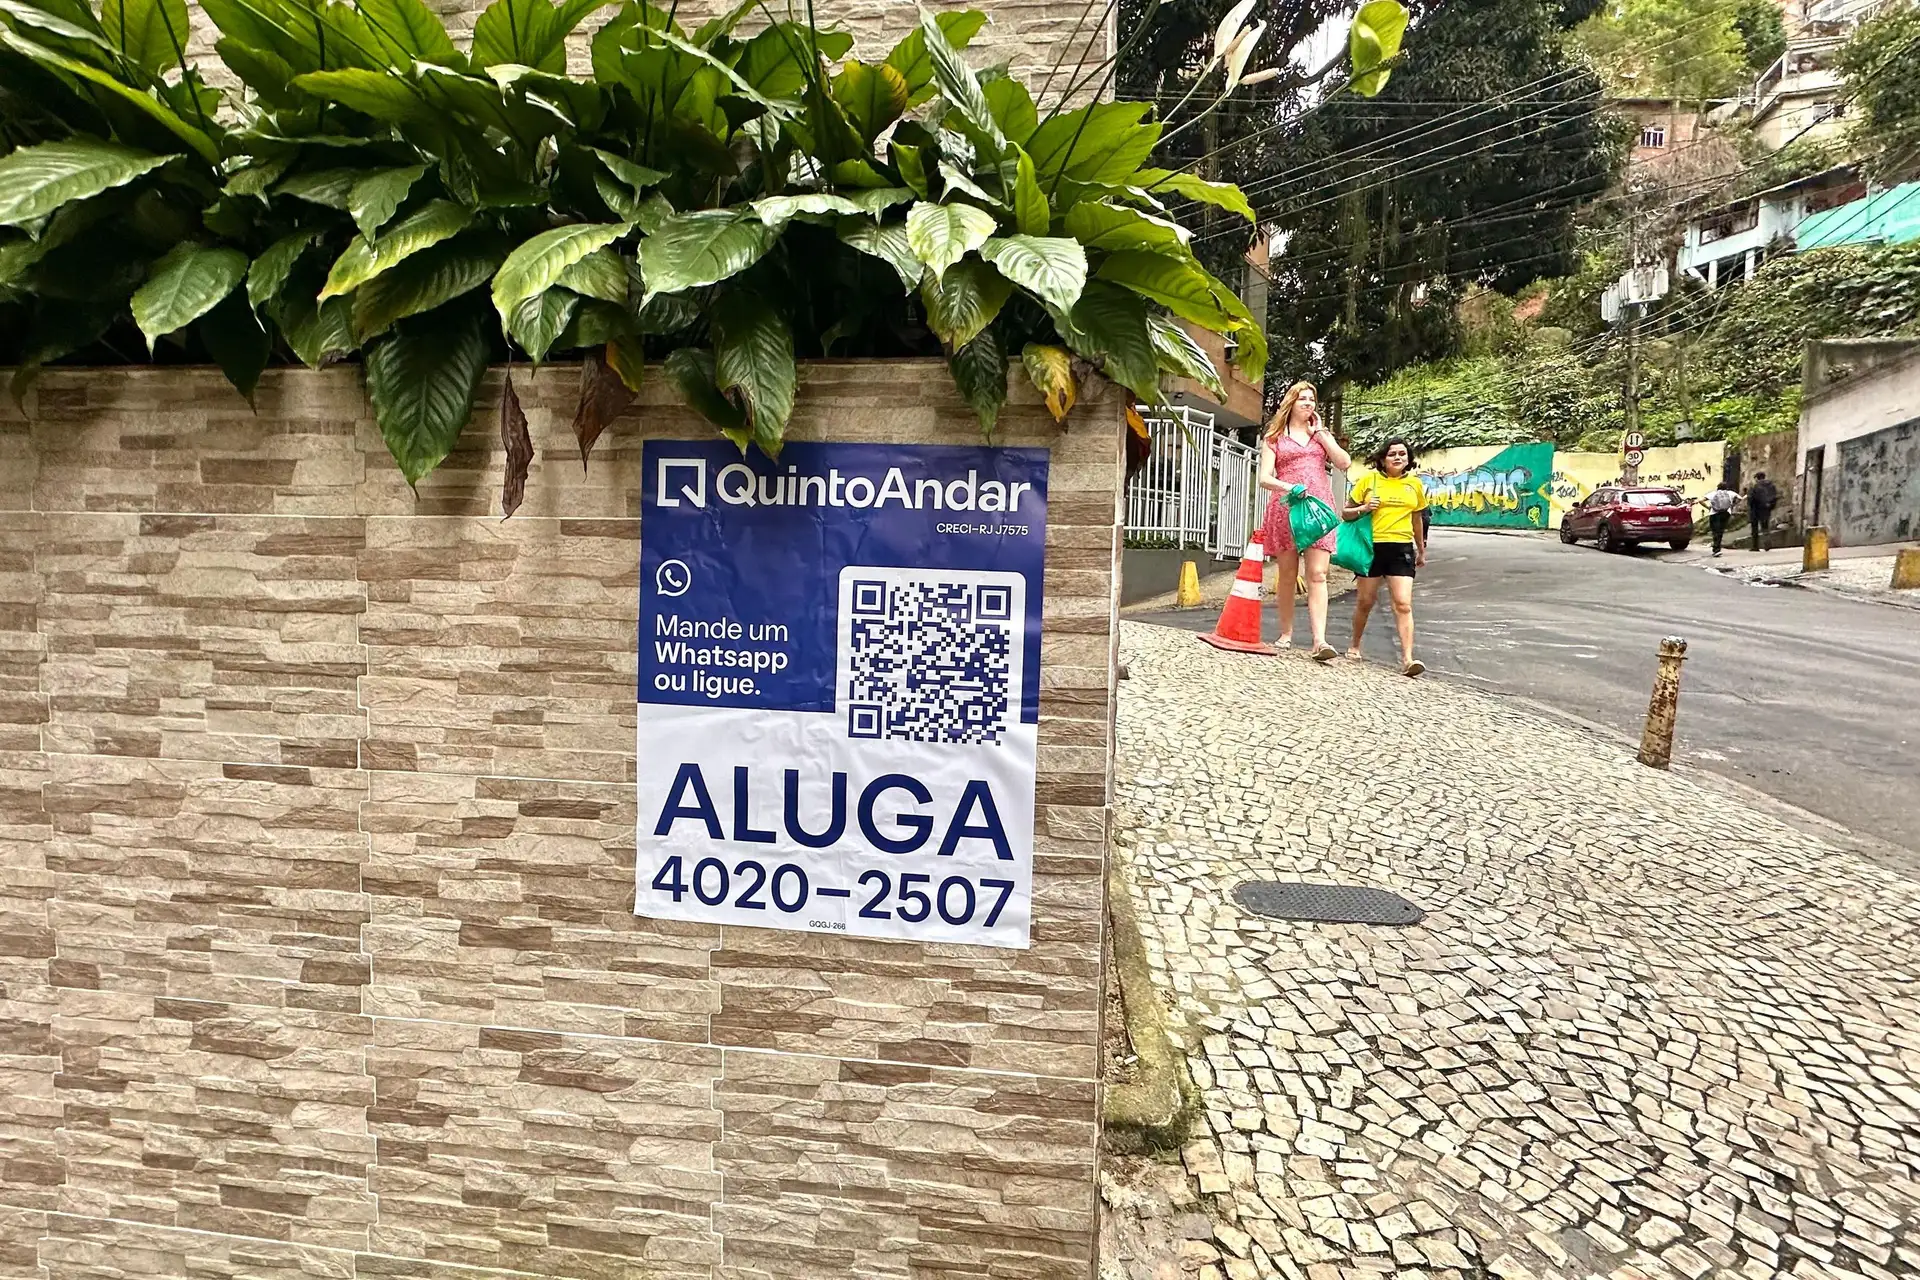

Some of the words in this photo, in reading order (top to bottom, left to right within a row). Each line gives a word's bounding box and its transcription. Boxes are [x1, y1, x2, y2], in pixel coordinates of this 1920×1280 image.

[716, 465, 1031, 512] QuintoAndar
[995, 525, 1028, 536] J7575
[656, 614, 743, 640] Mande
[749, 624, 788, 641] um
[655, 641, 788, 674] Whatsapp
[654, 673, 686, 691] ou
[692, 670, 761, 699] ligue.
[653, 763, 1014, 861] ALUGA
[651, 856, 1015, 927] 4020-2507
